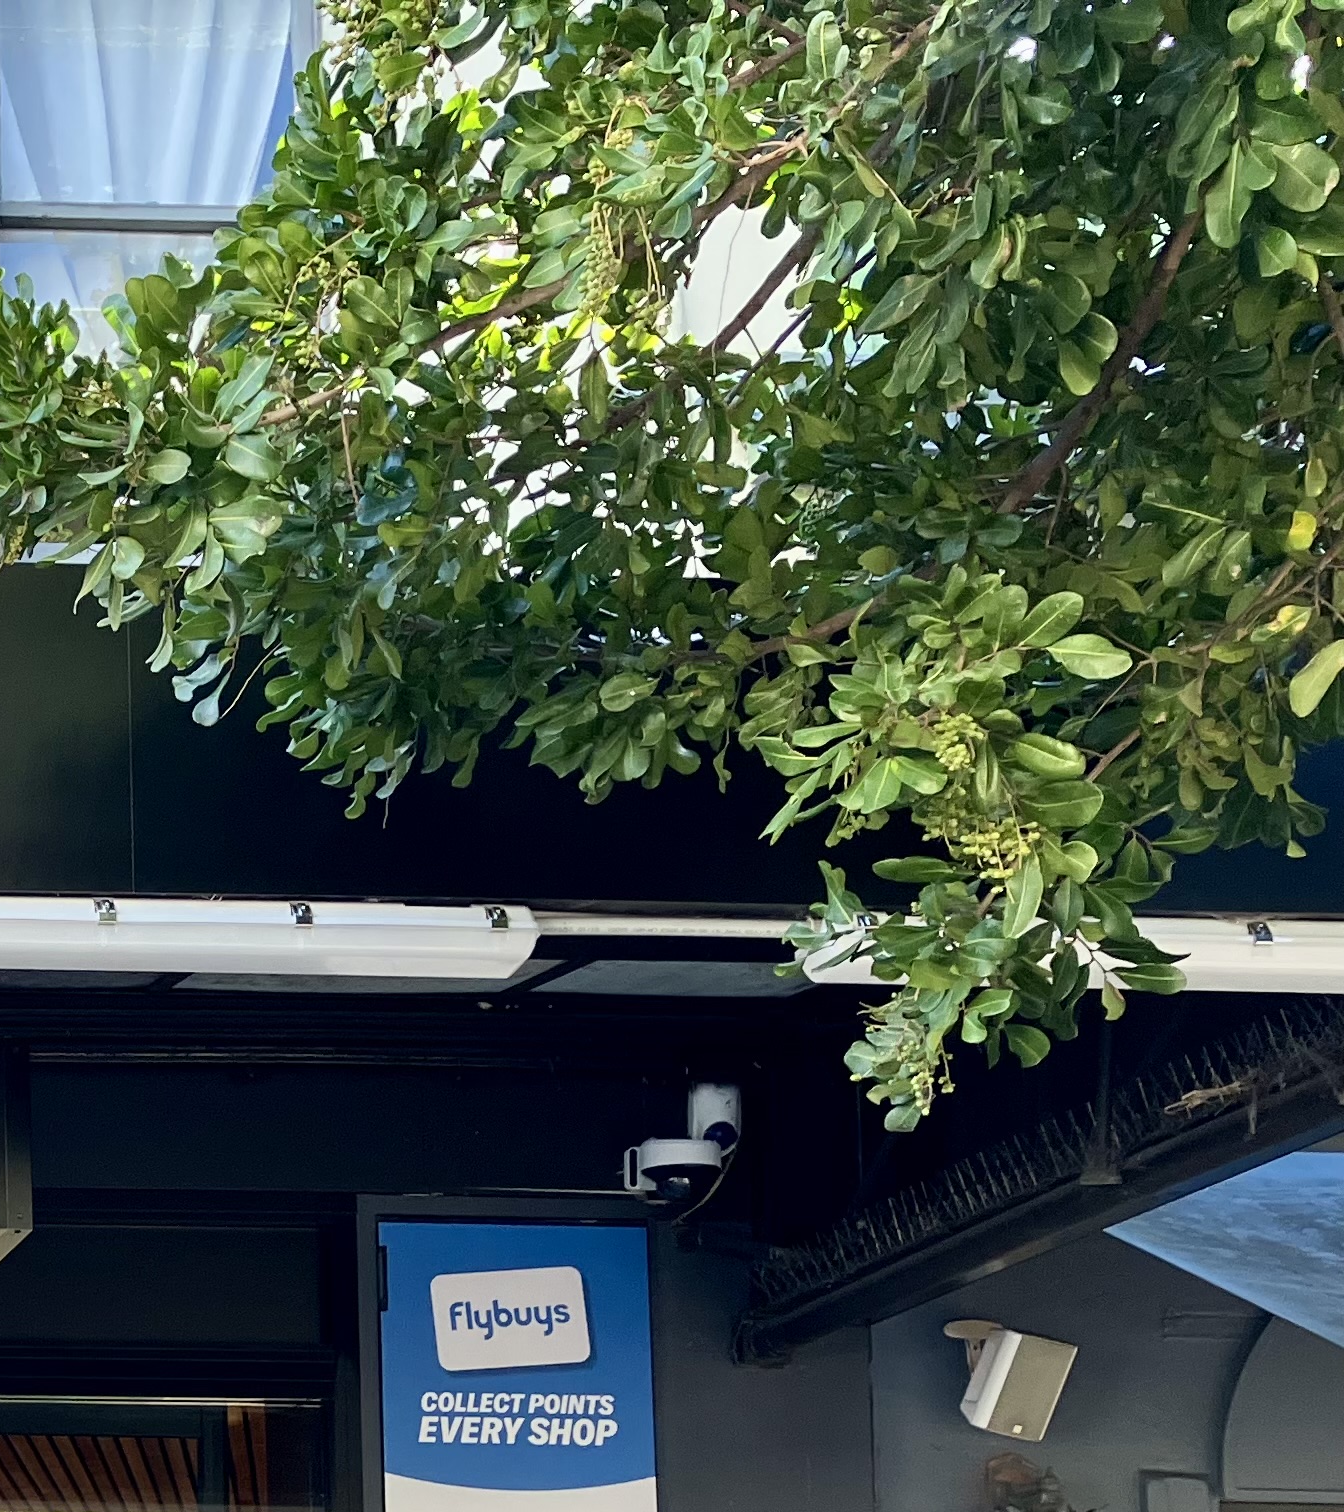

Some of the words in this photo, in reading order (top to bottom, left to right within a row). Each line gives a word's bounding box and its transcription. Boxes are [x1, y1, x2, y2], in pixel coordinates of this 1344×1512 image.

[449, 1300, 570, 1340] flybuys
[421, 1391, 525, 1414] COLLECT
[528, 1393, 614, 1416] POINTS
[418, 1416, 525, 1444] EVERY
[528, 1418, 619, 1447] SHOP
